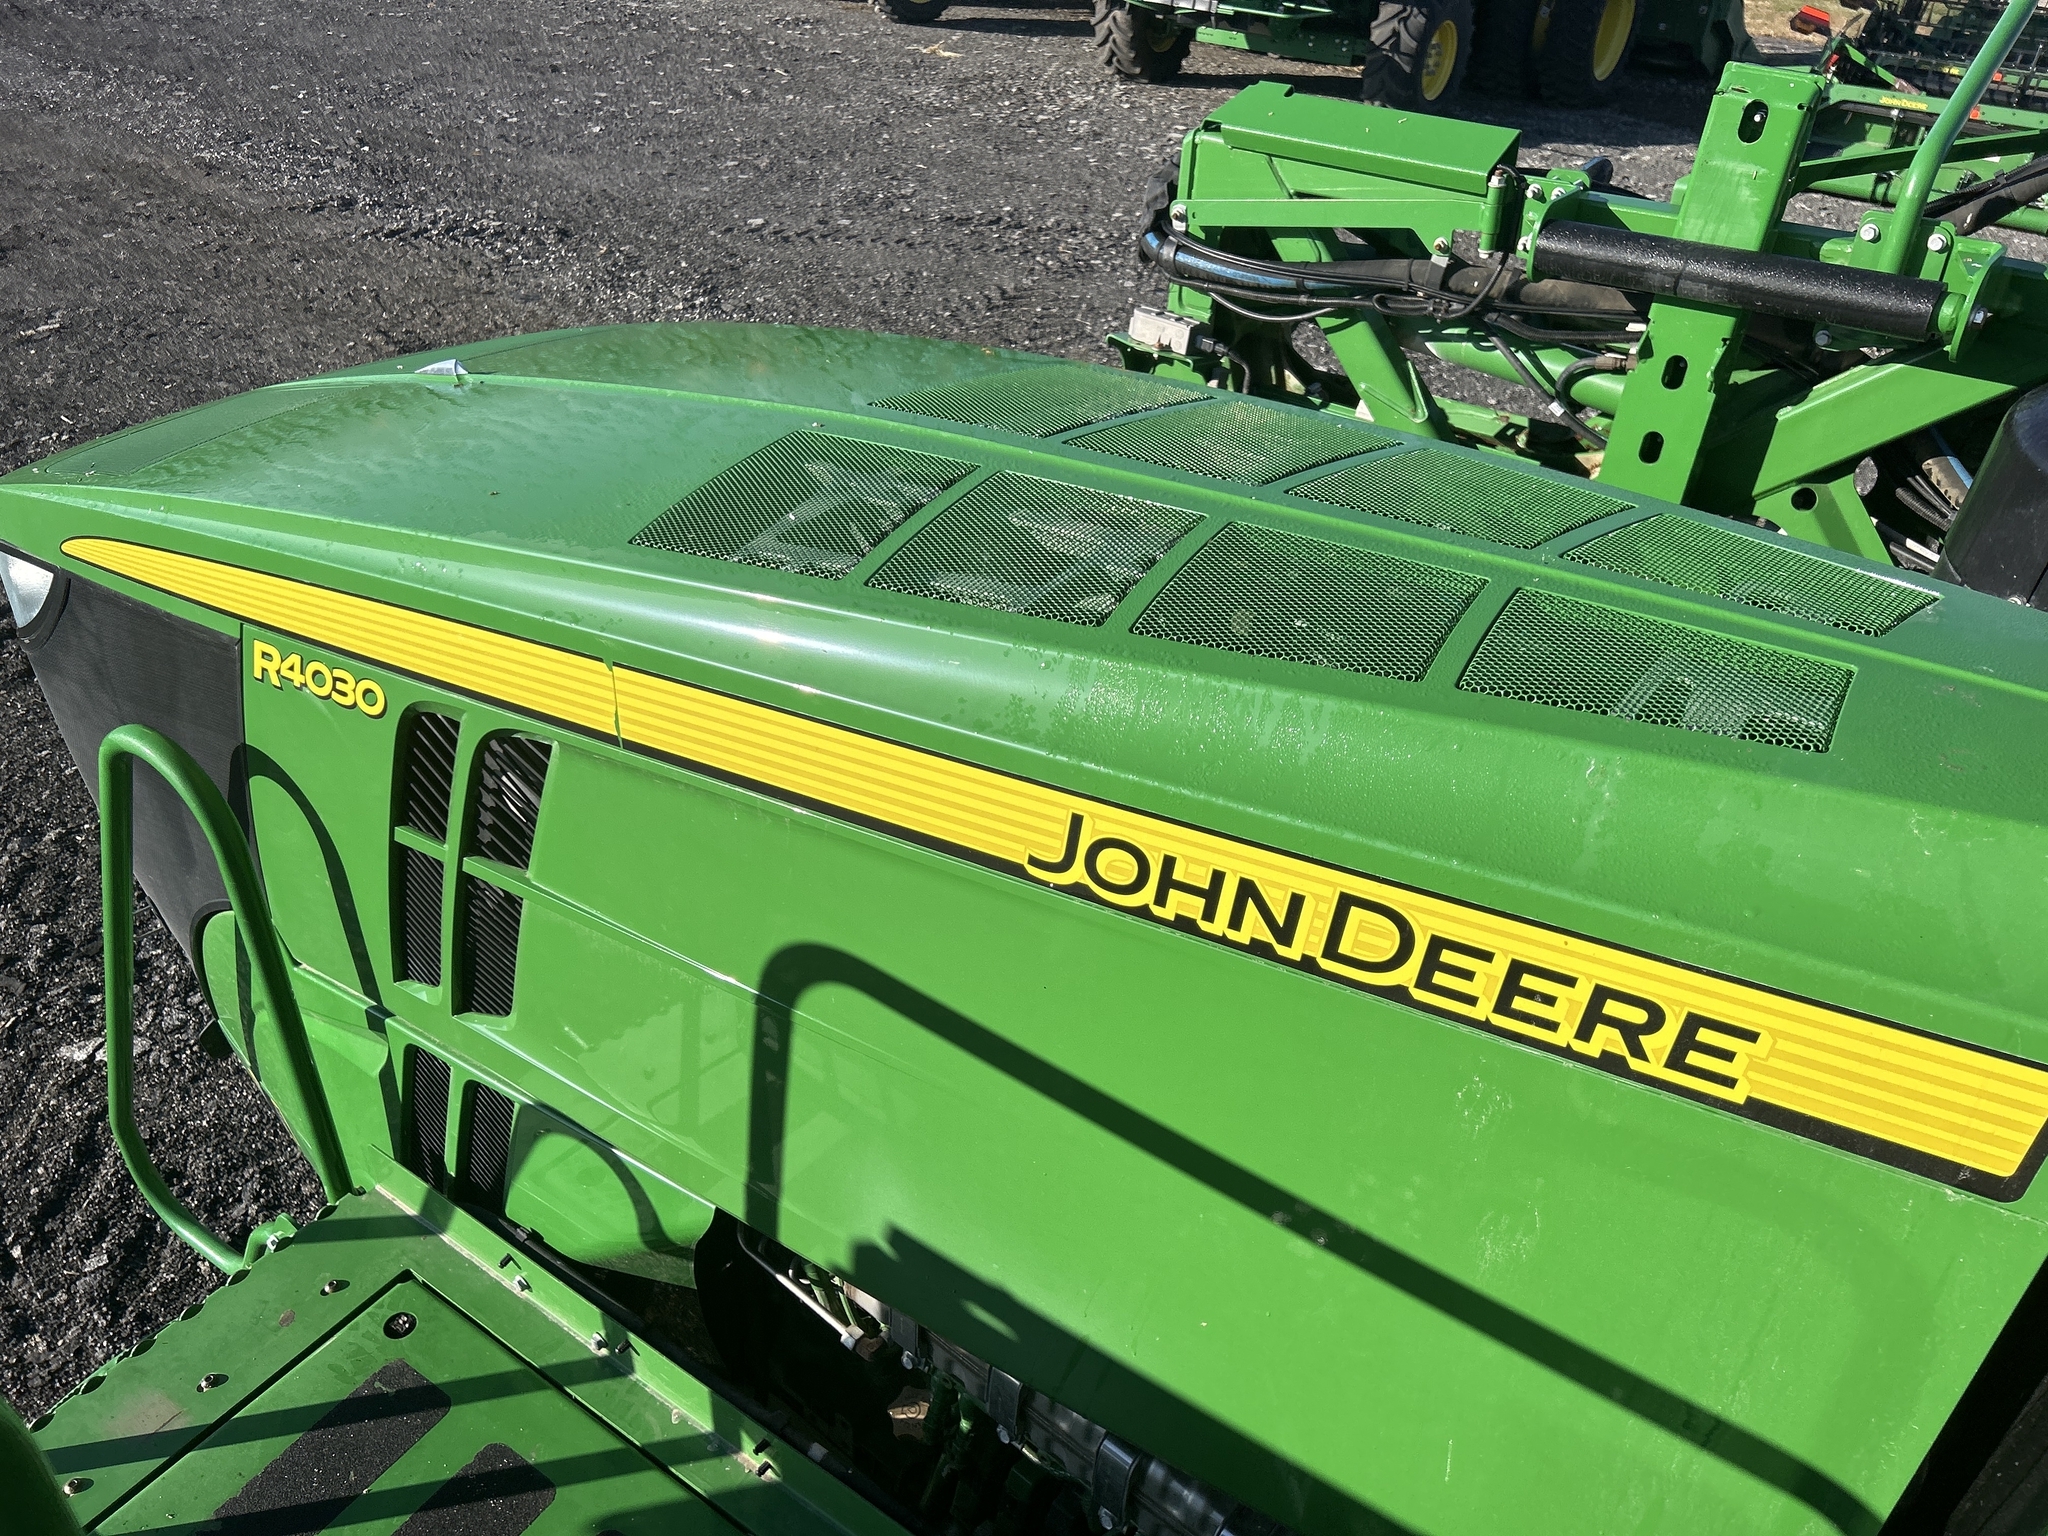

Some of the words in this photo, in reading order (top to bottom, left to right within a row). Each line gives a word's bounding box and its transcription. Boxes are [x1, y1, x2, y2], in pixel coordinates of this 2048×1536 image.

[253, 639, 387, 718] R4030
[1026, 812, 1306, 956] JOHN
[1322, 890, 1762, 1090] DEERE
